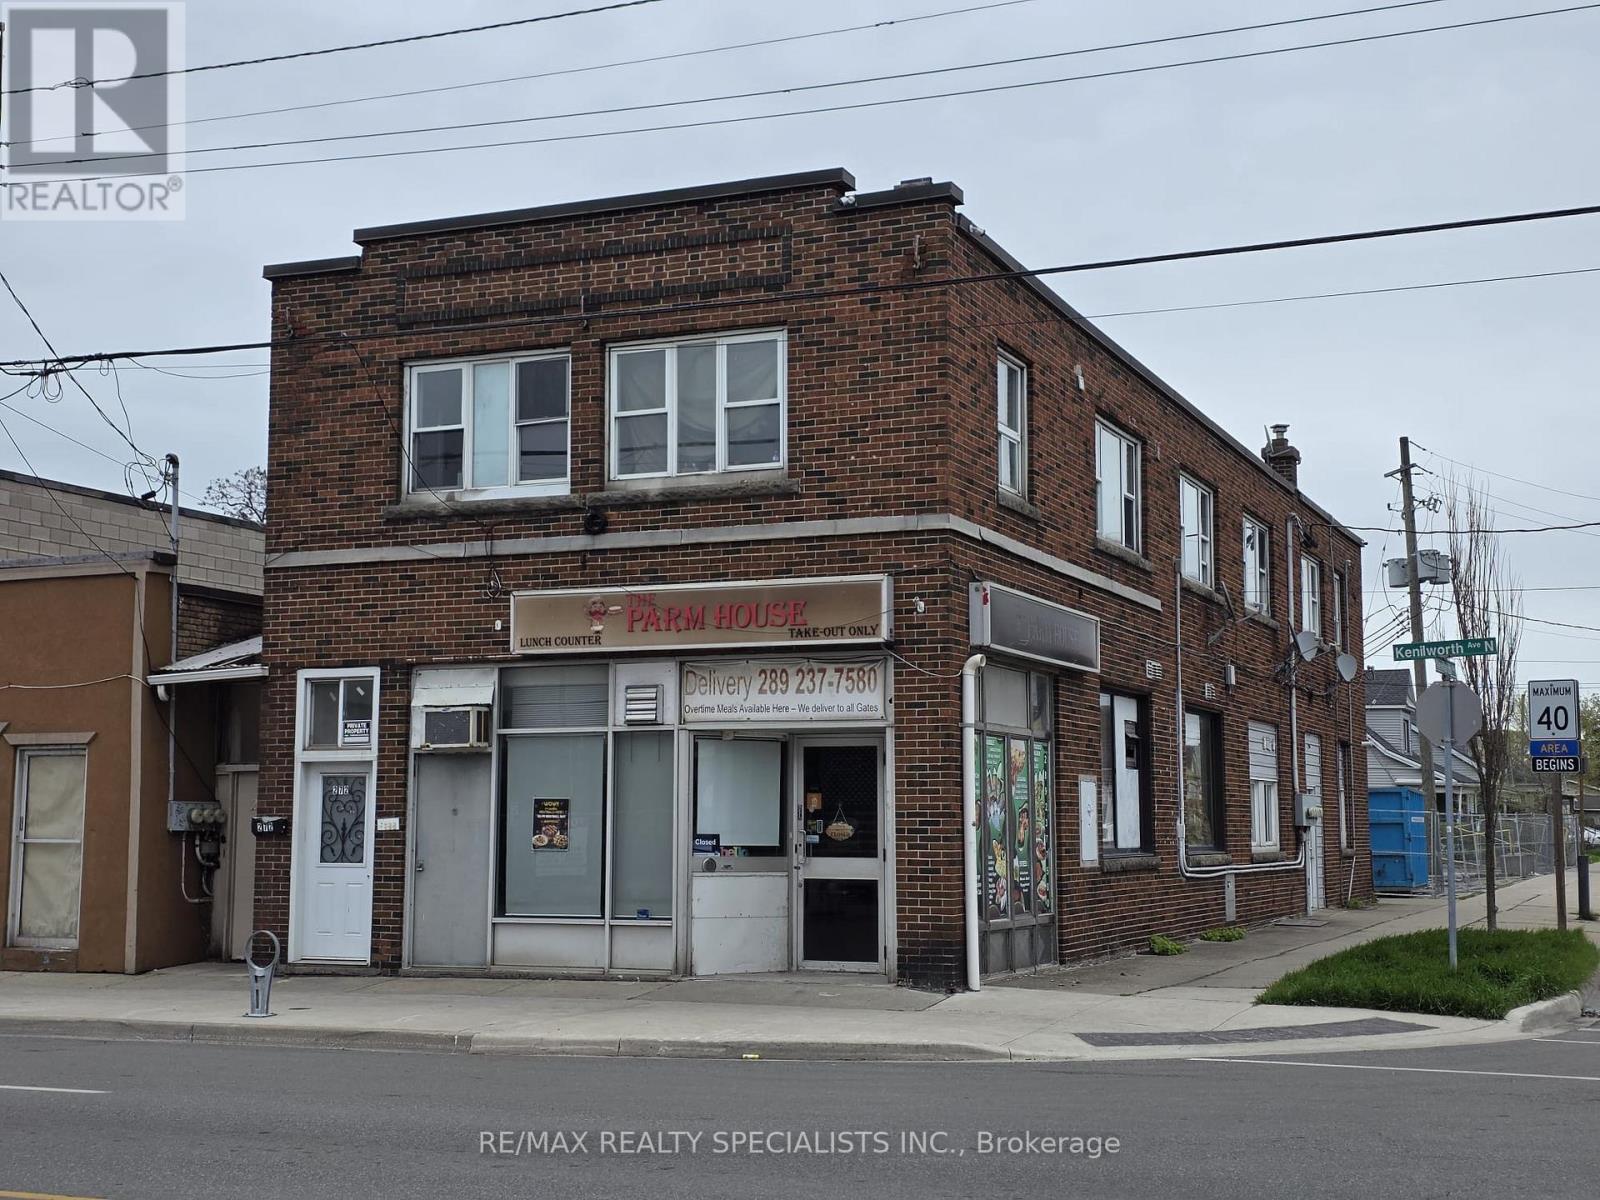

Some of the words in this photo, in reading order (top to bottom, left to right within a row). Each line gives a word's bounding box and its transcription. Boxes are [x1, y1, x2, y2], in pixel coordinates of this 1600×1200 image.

[626, 605, 706, 633] PARM
[714, 600, 808, 630] HOUSE
[788, 626, 846, 639] TAKE-OUT
[849, 624, 879, 636] ONLY
[520, 637, 552, 648] LUNCH
[554, 635, 602, 647] COUNTER
[1395, 643, 1464, 659] Kenilworth
[1467, 641, 1481, 649] Ave
[1484, 640, 1495, 652] N
[685, 669, 752, 702] Delivery
[758, 667, 790, 695] 289
[795, 665, 877, 694] 237-7580
[1532, 686, 1572, 697] MAXIMUM
[684, 704, 715, 714] Overtime
[717, 704, 738, 714] Meals
[739, 703, 771, 713] Available
[772, 703, 790, 713] Here
[797, 703, 810, 713] We
[811, 703, 835, 713] deliver
[837, 703, 845, 712] to
[846, 702, 855, 712] all
[856, 702, 879, 712] Gates
[1537, 705, 1569, 731] 40
[1540, 743, 1568, 753] AREA
[1536, 758, 1575, 771] BEGINS
[695, 838, 716, 846] Closed
